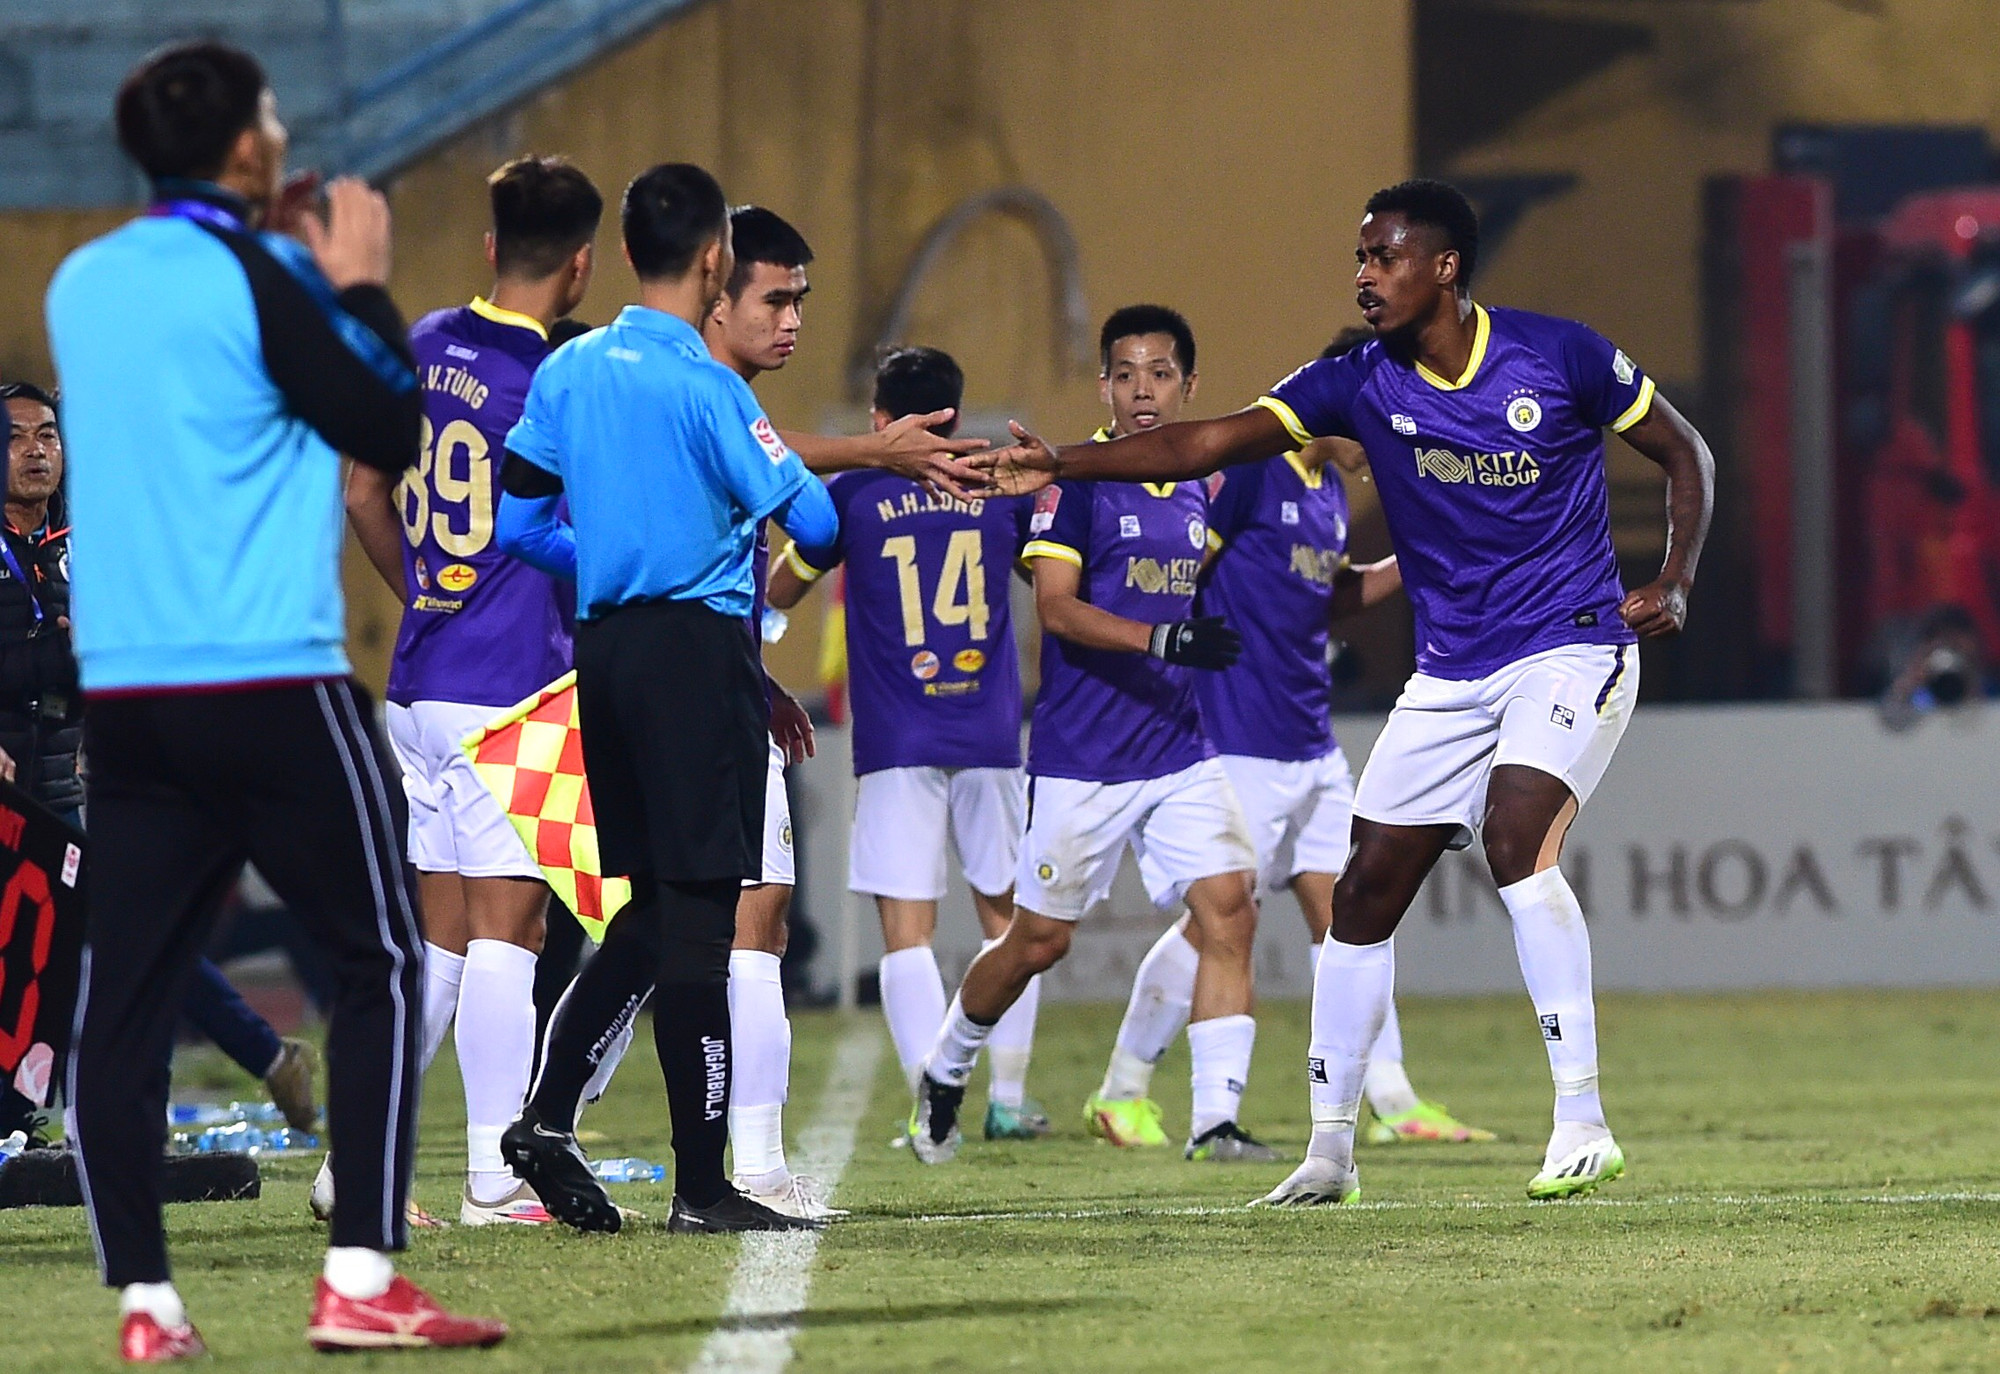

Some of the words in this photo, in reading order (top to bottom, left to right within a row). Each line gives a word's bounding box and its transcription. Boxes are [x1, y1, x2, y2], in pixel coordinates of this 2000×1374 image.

[390, 412, 493, 558] 89
[1473, 450, 1538, 474] KITA
[1478, 468, 1541, 488] GROUP
[876, 490, 986, 523] N.H.LONG
[881, 529, 990, 647] 14
[700, 1035, 726, 1121] JOGARBOLA
